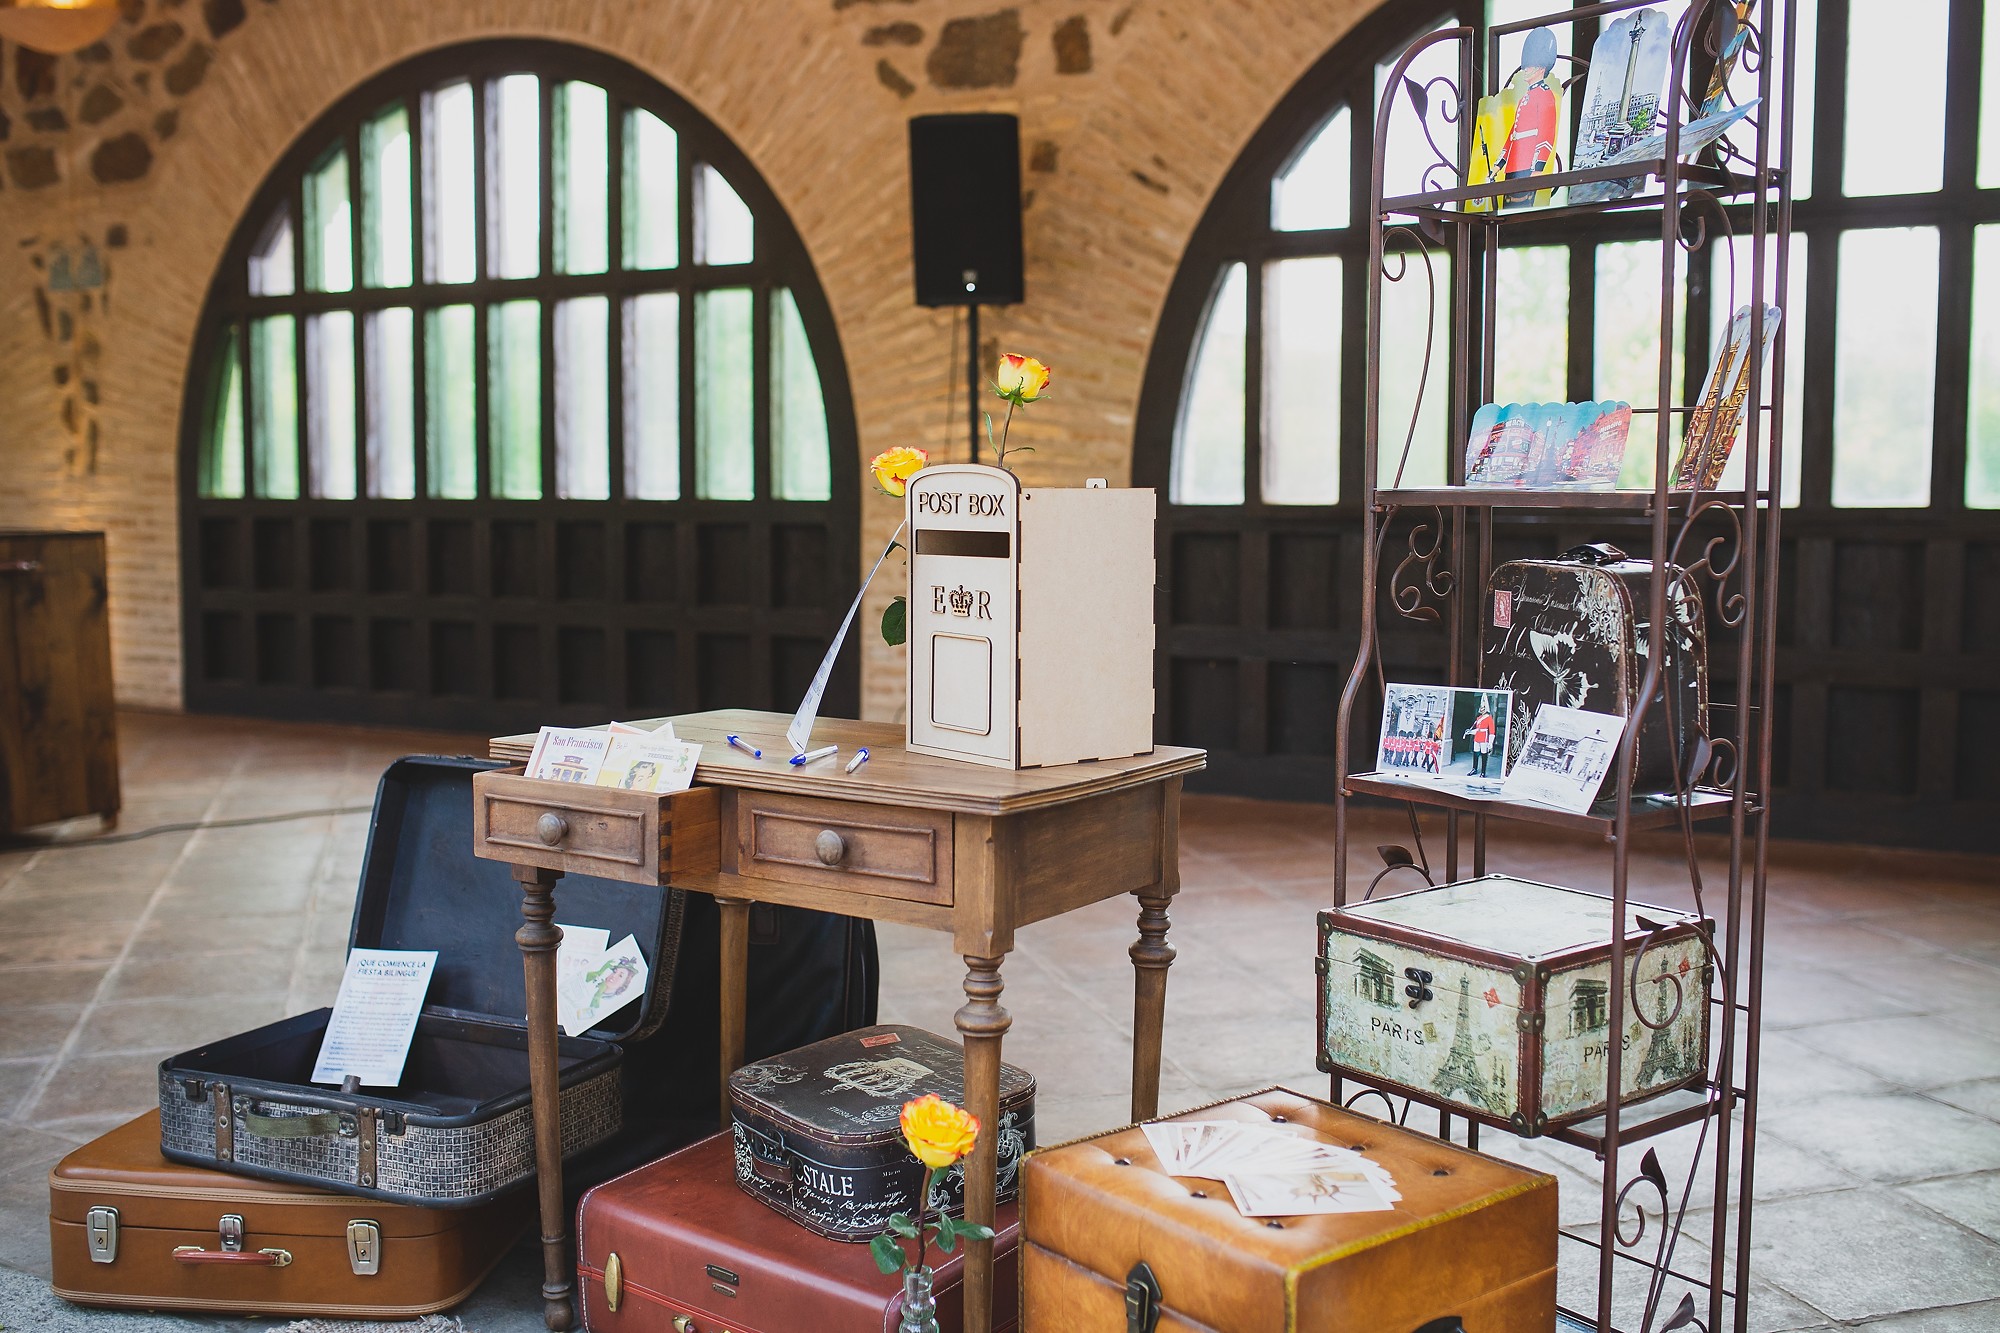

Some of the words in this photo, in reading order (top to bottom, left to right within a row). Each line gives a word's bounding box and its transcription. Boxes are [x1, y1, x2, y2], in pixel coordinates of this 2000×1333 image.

[918, 491, 963, 514] POST
[968, 494, 1005, 517] BOX
[930, 585, 947, 615] E
[974, 589, 993, 620] R
[552, 735, 567, 747] San
[566, 736, 604, 750] Francisco
[357, 968, 382, 976] FIESTA
[377, 959, 417, 968] COMIENCE
[417, 960, 426, 968] LA
[1371, 1016, 1425, 1046] PARIS
[1583, 1034, 1630, 1063] PARS
[796, 1164, 855, 1197] STALE
